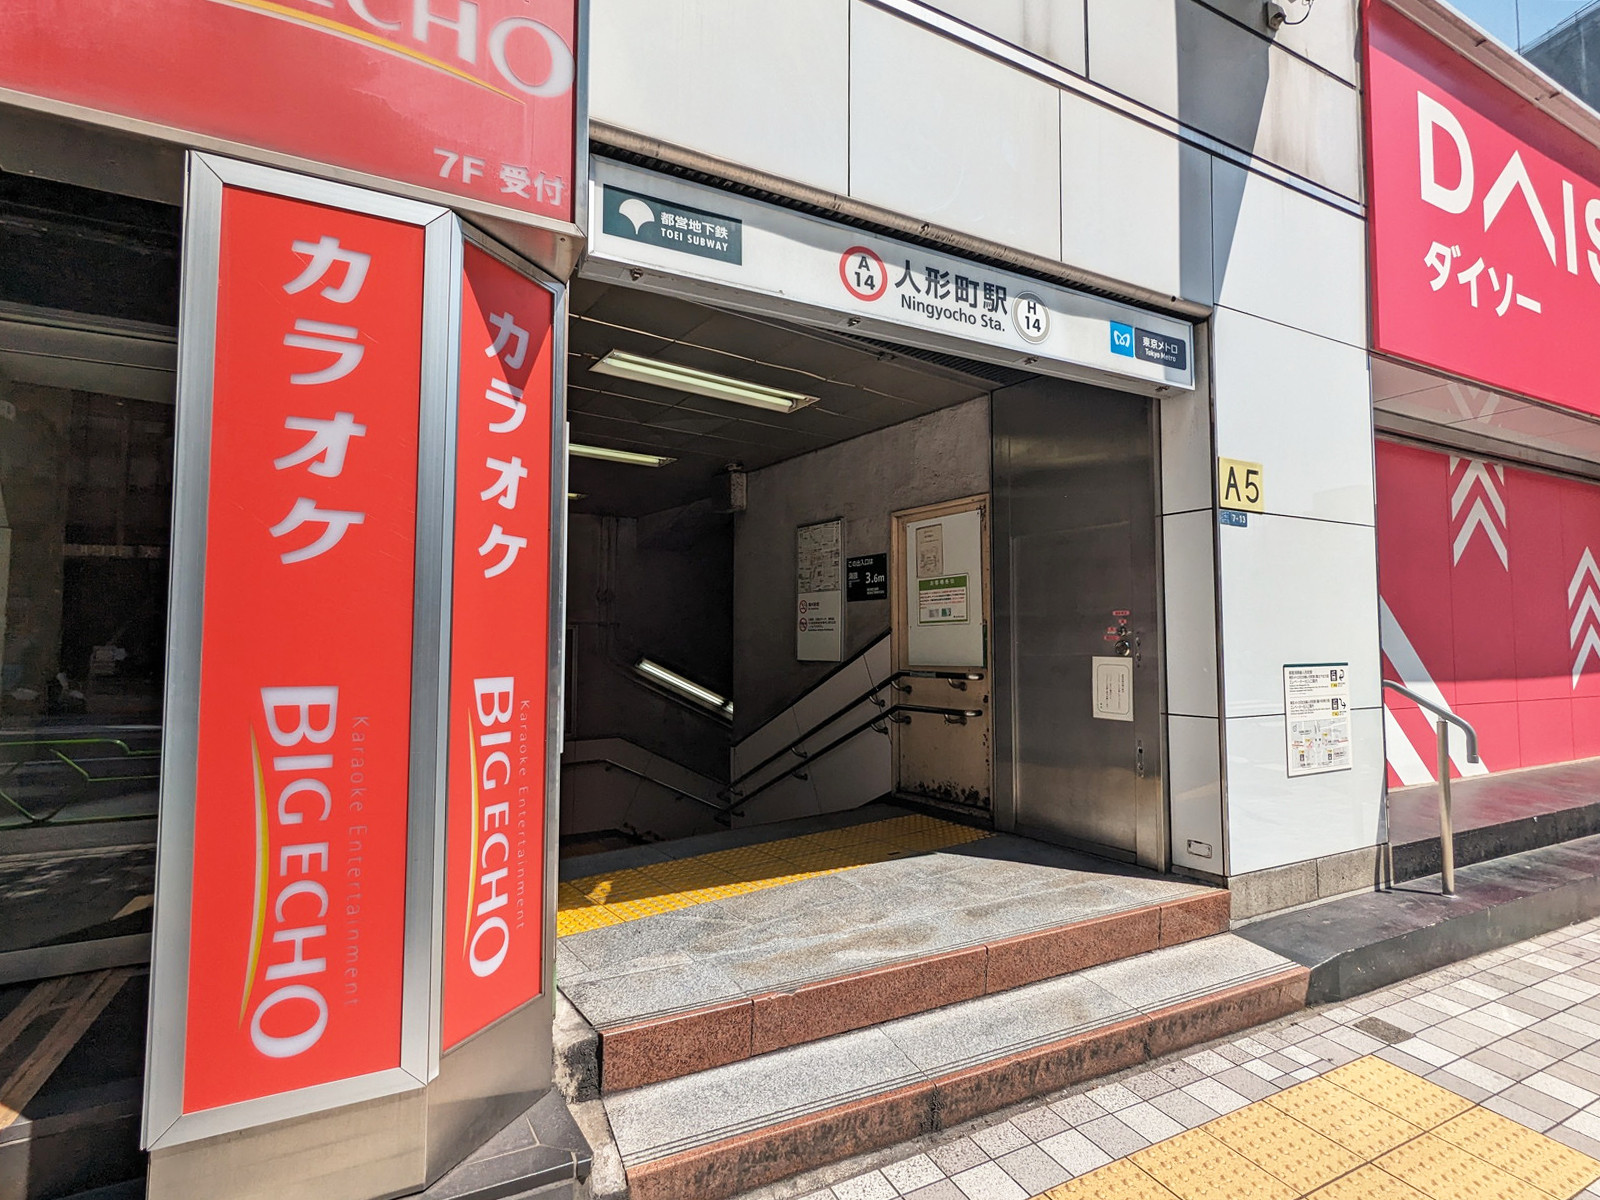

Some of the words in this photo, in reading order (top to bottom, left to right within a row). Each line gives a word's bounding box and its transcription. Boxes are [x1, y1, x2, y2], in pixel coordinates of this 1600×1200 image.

[303, 0, 574, 97] HO
[433, 147, 486, 184] 7F
[500, 162, 565, 206] 受付
[660, 211, 729, 240] 都営地下鉄
[660, 228, 683, 242] TOEI
[687, 234, 729, 252] SUBWAY
[854, 271, 875, 290] 14
[858, 256, 870, 272] A
[894, 259, 1008, 316] 人形町駅
[1423, 240, 1541, 317] ダイソー
[901, 294, 976, 325] Ningyocho
[980, 314, 1006, 332] Sta.
[1025, 316, 1041, 332] 14
[1027, 301, 1037, 315] H
[1142, 336, 1178, 354] 東京メトロ
[269, 234, 372, 564] カラオケ
[478, 311, 530, 578] カラオケ
[1225, 466, 1259, 503] A5
[865, 571, 885, 584] 3.6m
[260, 686, 339, 825] BIG
[349, 715, 369, 812] Karaoke
[474, 676, 514, 790] BIG
[519, 699, 530, 776] Karaoke
[469, 801, 509, 978] ECHO
[515, 785, 528, 930] Entertainment
[343, 824, 368, 1006] Entertainment
[250, 842, 329, 1058] ECHO
